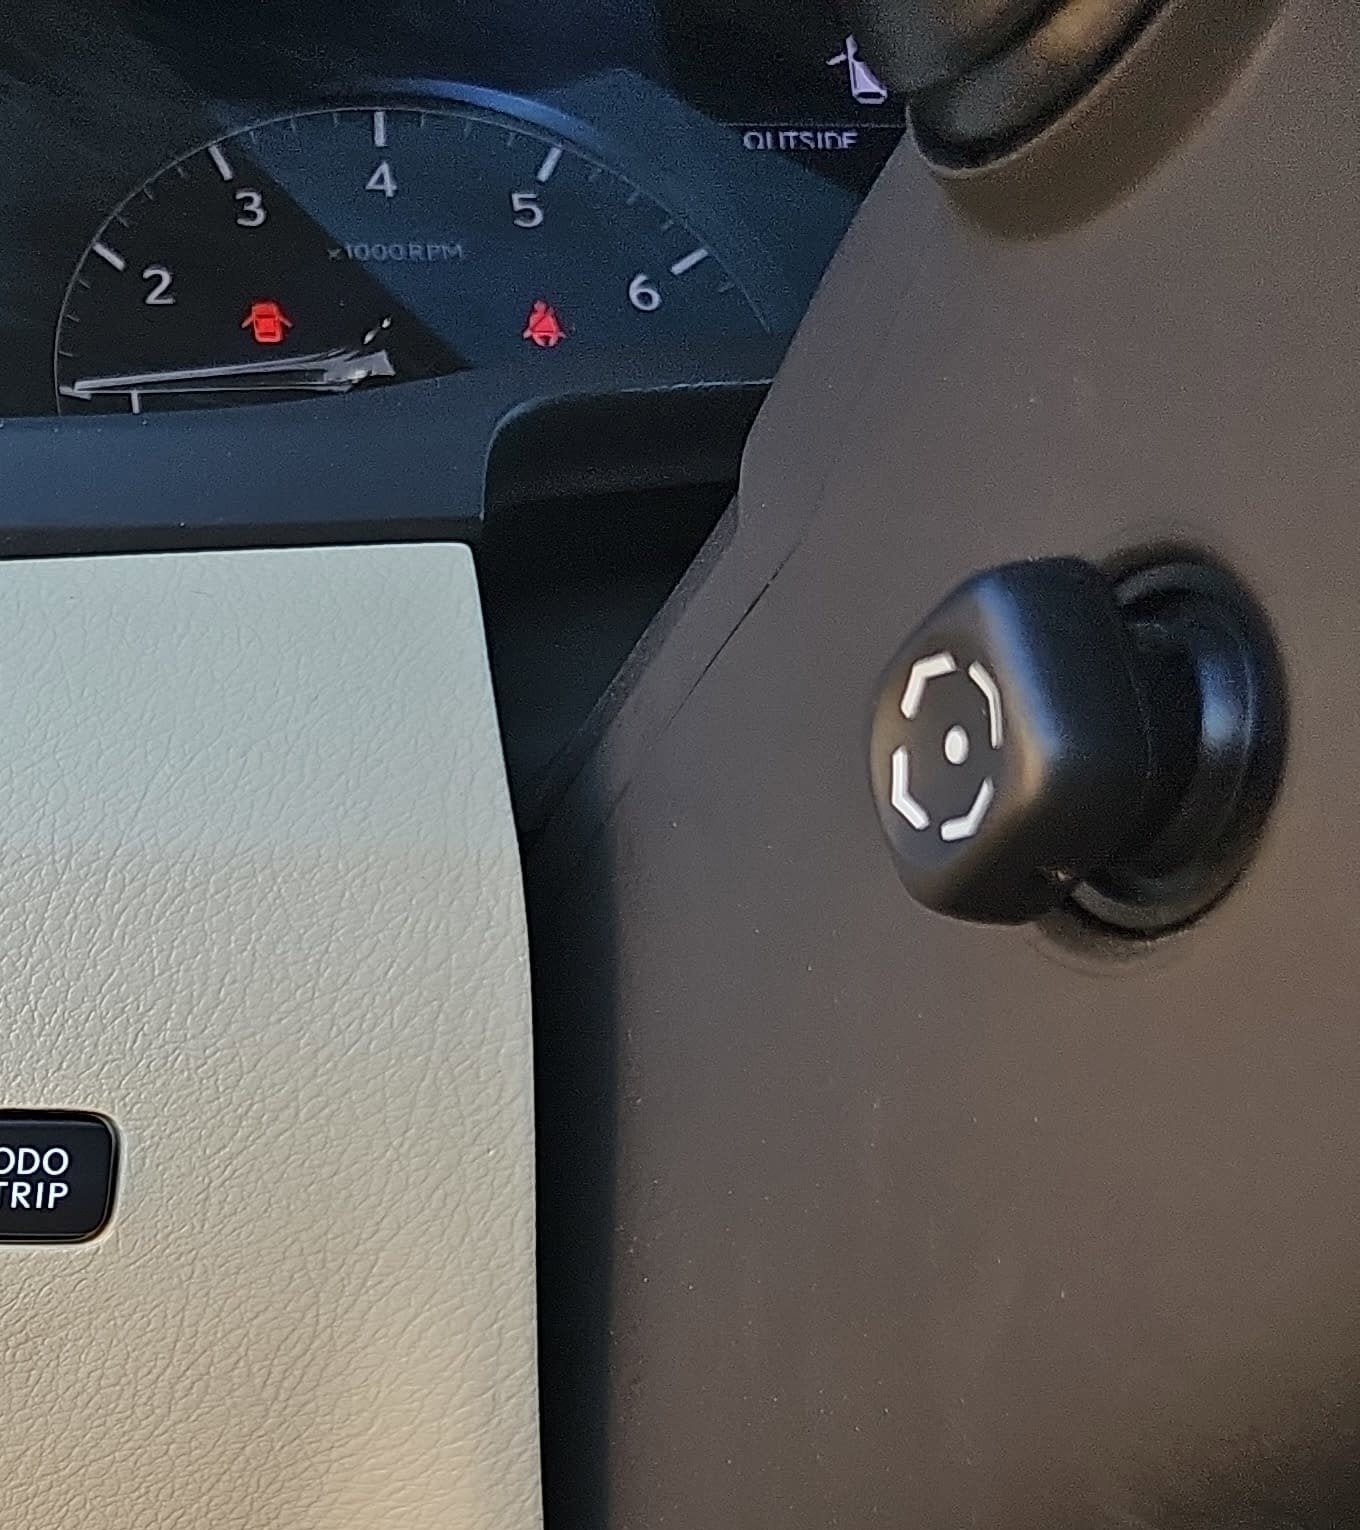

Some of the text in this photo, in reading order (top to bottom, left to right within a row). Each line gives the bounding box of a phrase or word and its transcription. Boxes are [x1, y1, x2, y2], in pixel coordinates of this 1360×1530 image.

[366, 163, 397, 198] 4
[236, 190, 267, 227] 3
[511, 193, 543, 227] 5
[143, 269, 175, 305] 2
[629, 273, 662, 311] 6
